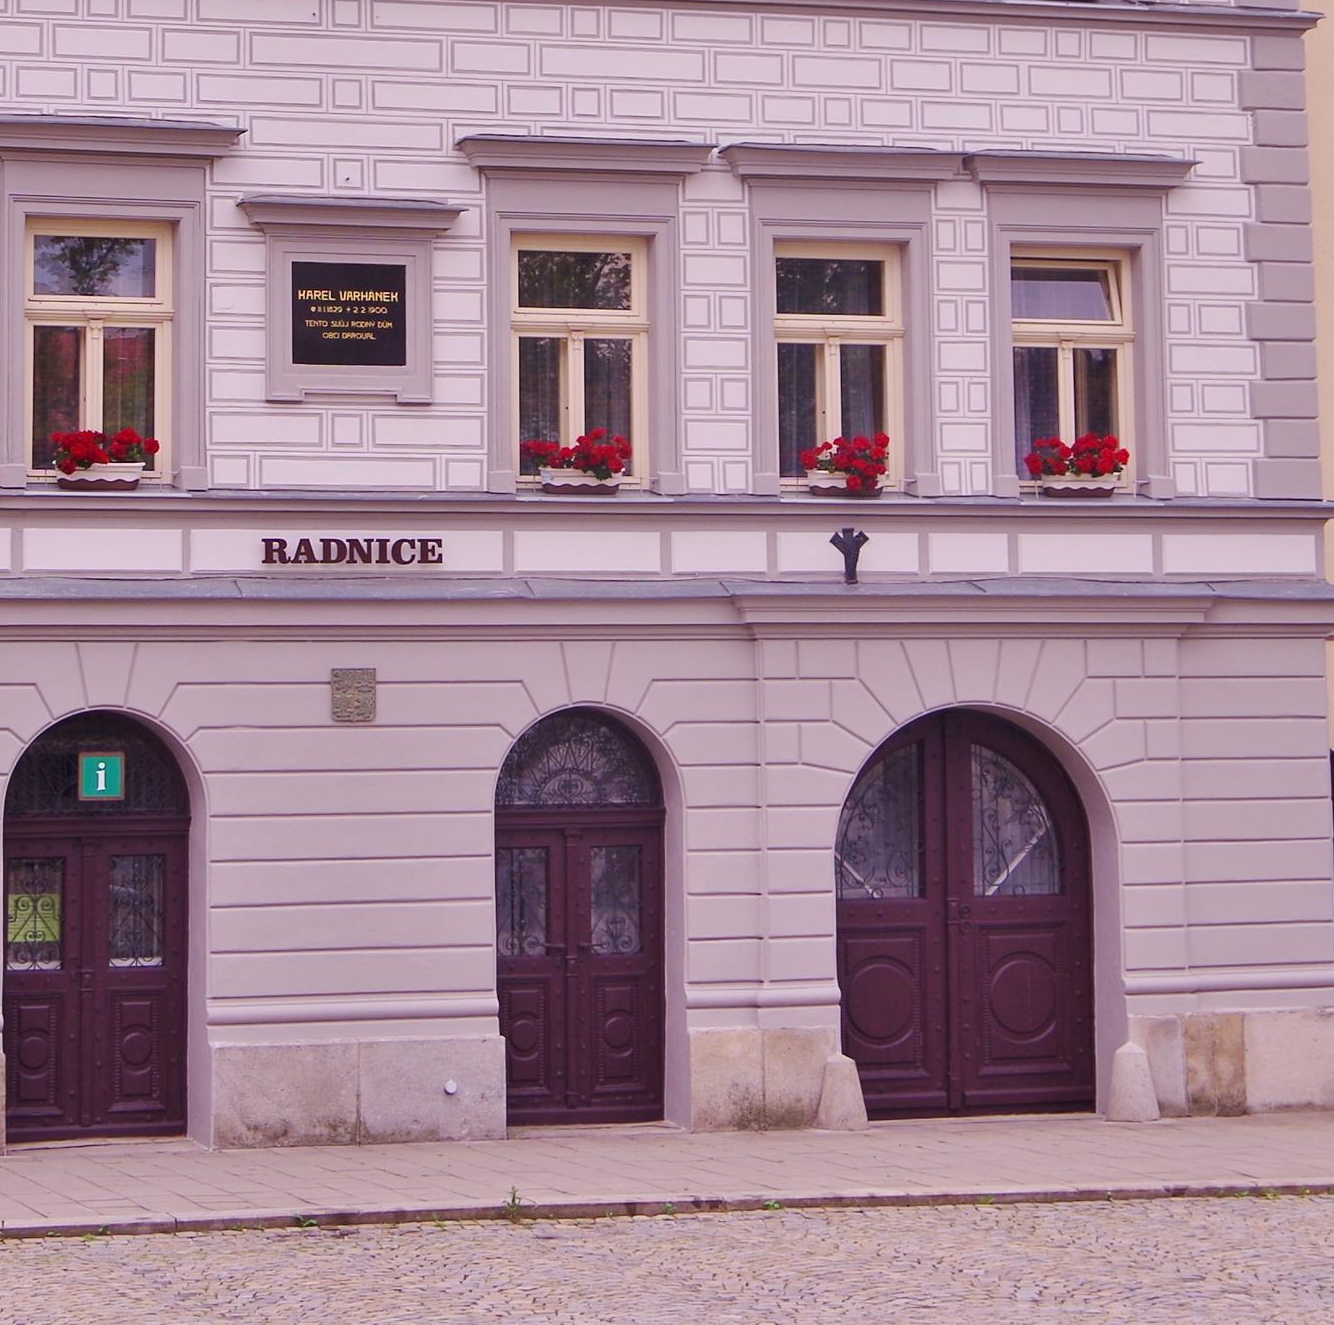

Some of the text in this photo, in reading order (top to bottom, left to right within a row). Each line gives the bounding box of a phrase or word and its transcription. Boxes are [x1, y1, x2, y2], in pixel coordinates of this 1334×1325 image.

[298, 289, 399, 302] KAREL VARHÁNEK
[305, 319, 328, 327] TENTO
[261, 538, 443, 565] RADNICE
[96, 762, 107, 791] i
